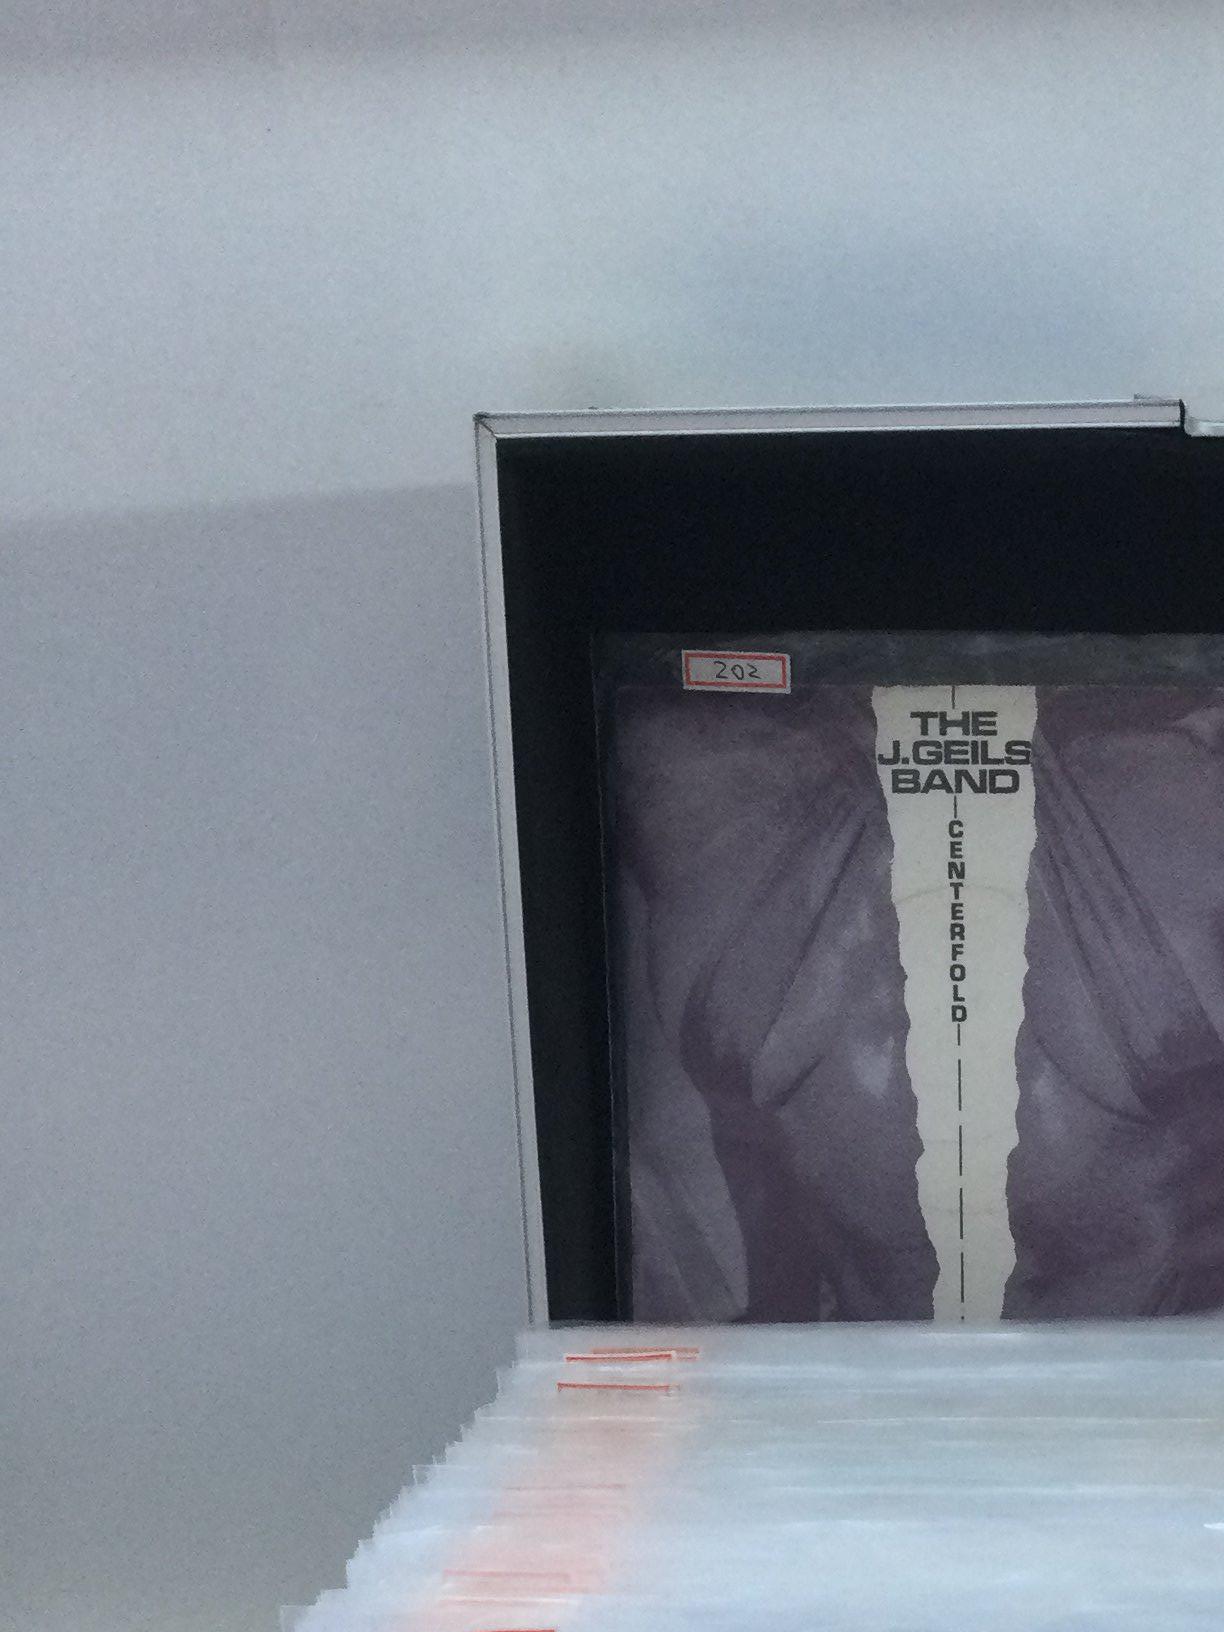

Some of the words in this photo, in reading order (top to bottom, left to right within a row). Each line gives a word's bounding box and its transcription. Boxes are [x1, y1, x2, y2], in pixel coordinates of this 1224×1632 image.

[714, 661, 761, 681] 202
[910, 711, 998, 737] THE
[878, 740, 1033, 765] J.GEILS
[891, 769, 1020, 794] BAND
[948, 820, 967, 1023] CENTERFOLD
